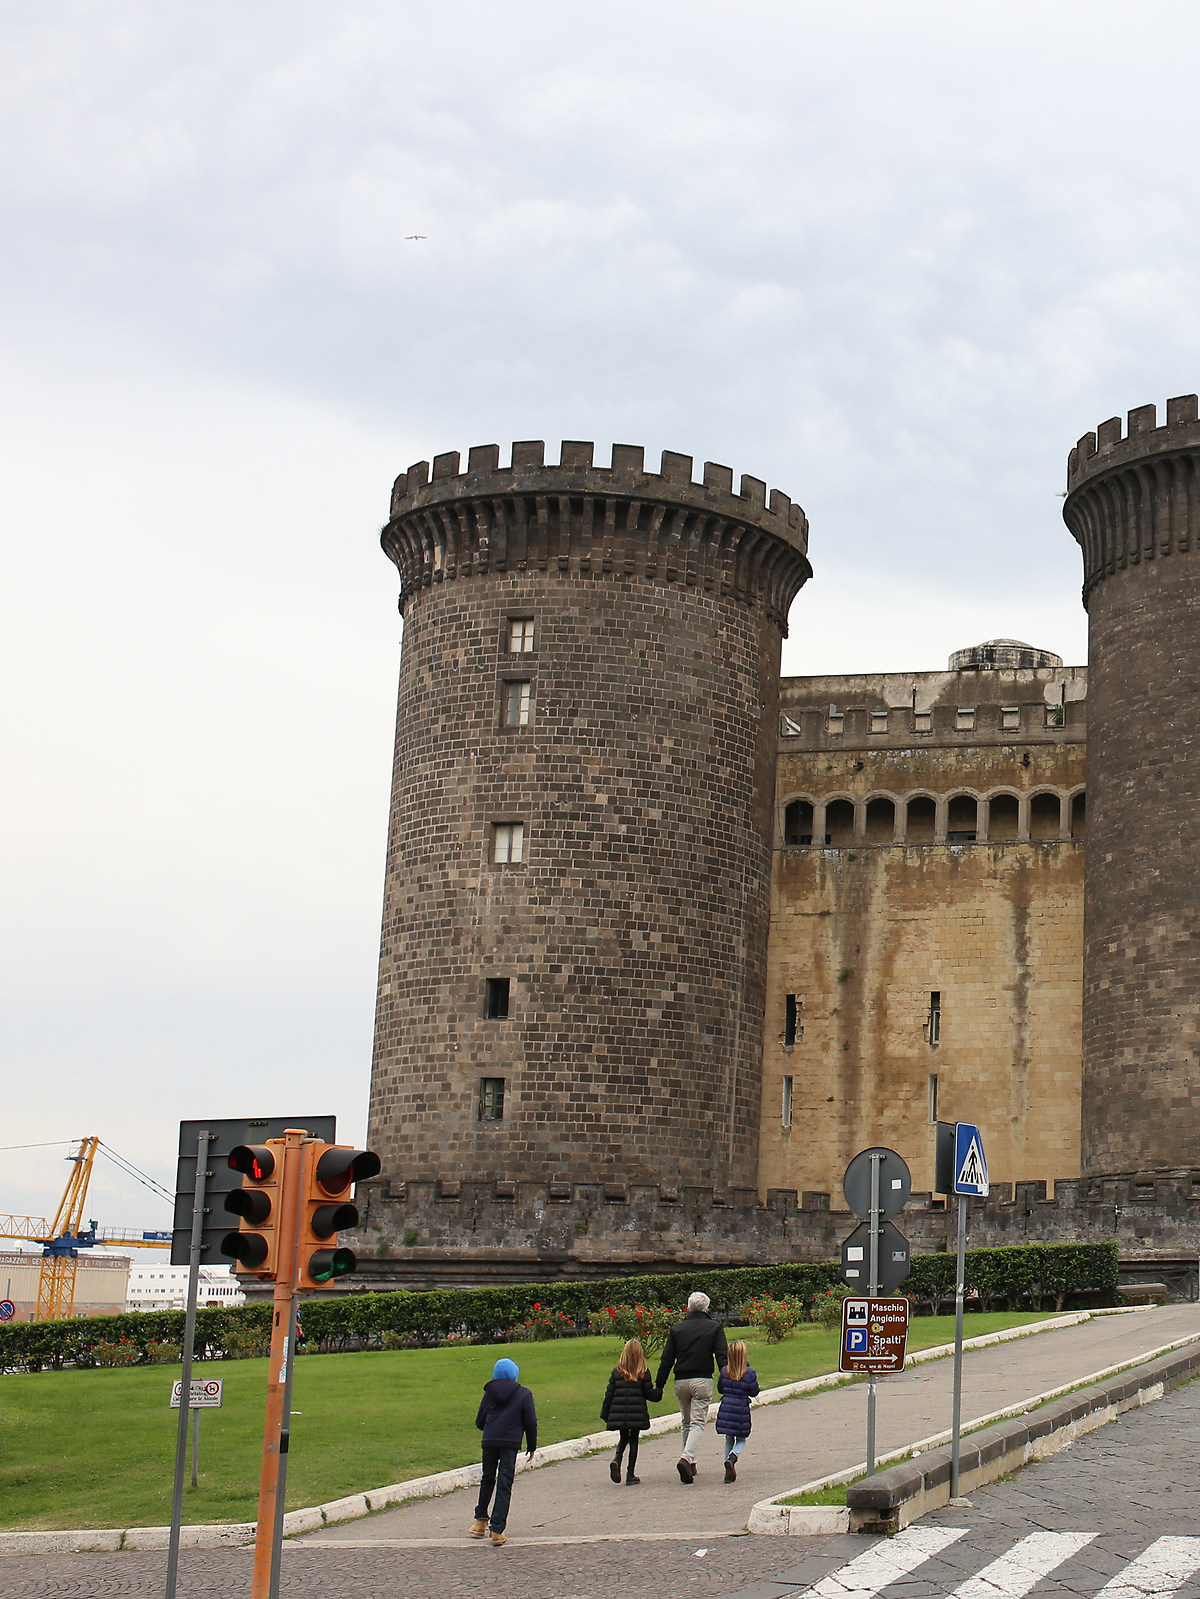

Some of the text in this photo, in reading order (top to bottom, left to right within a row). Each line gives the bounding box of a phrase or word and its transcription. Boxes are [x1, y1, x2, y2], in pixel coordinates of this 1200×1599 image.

[871, 1303, 904, 1312] Maschio
[870, 1314, 905, 1324] Angioino
[851, 1332, 863, 1349] P
[869, 1335, 905, 1346] "Spalti"
